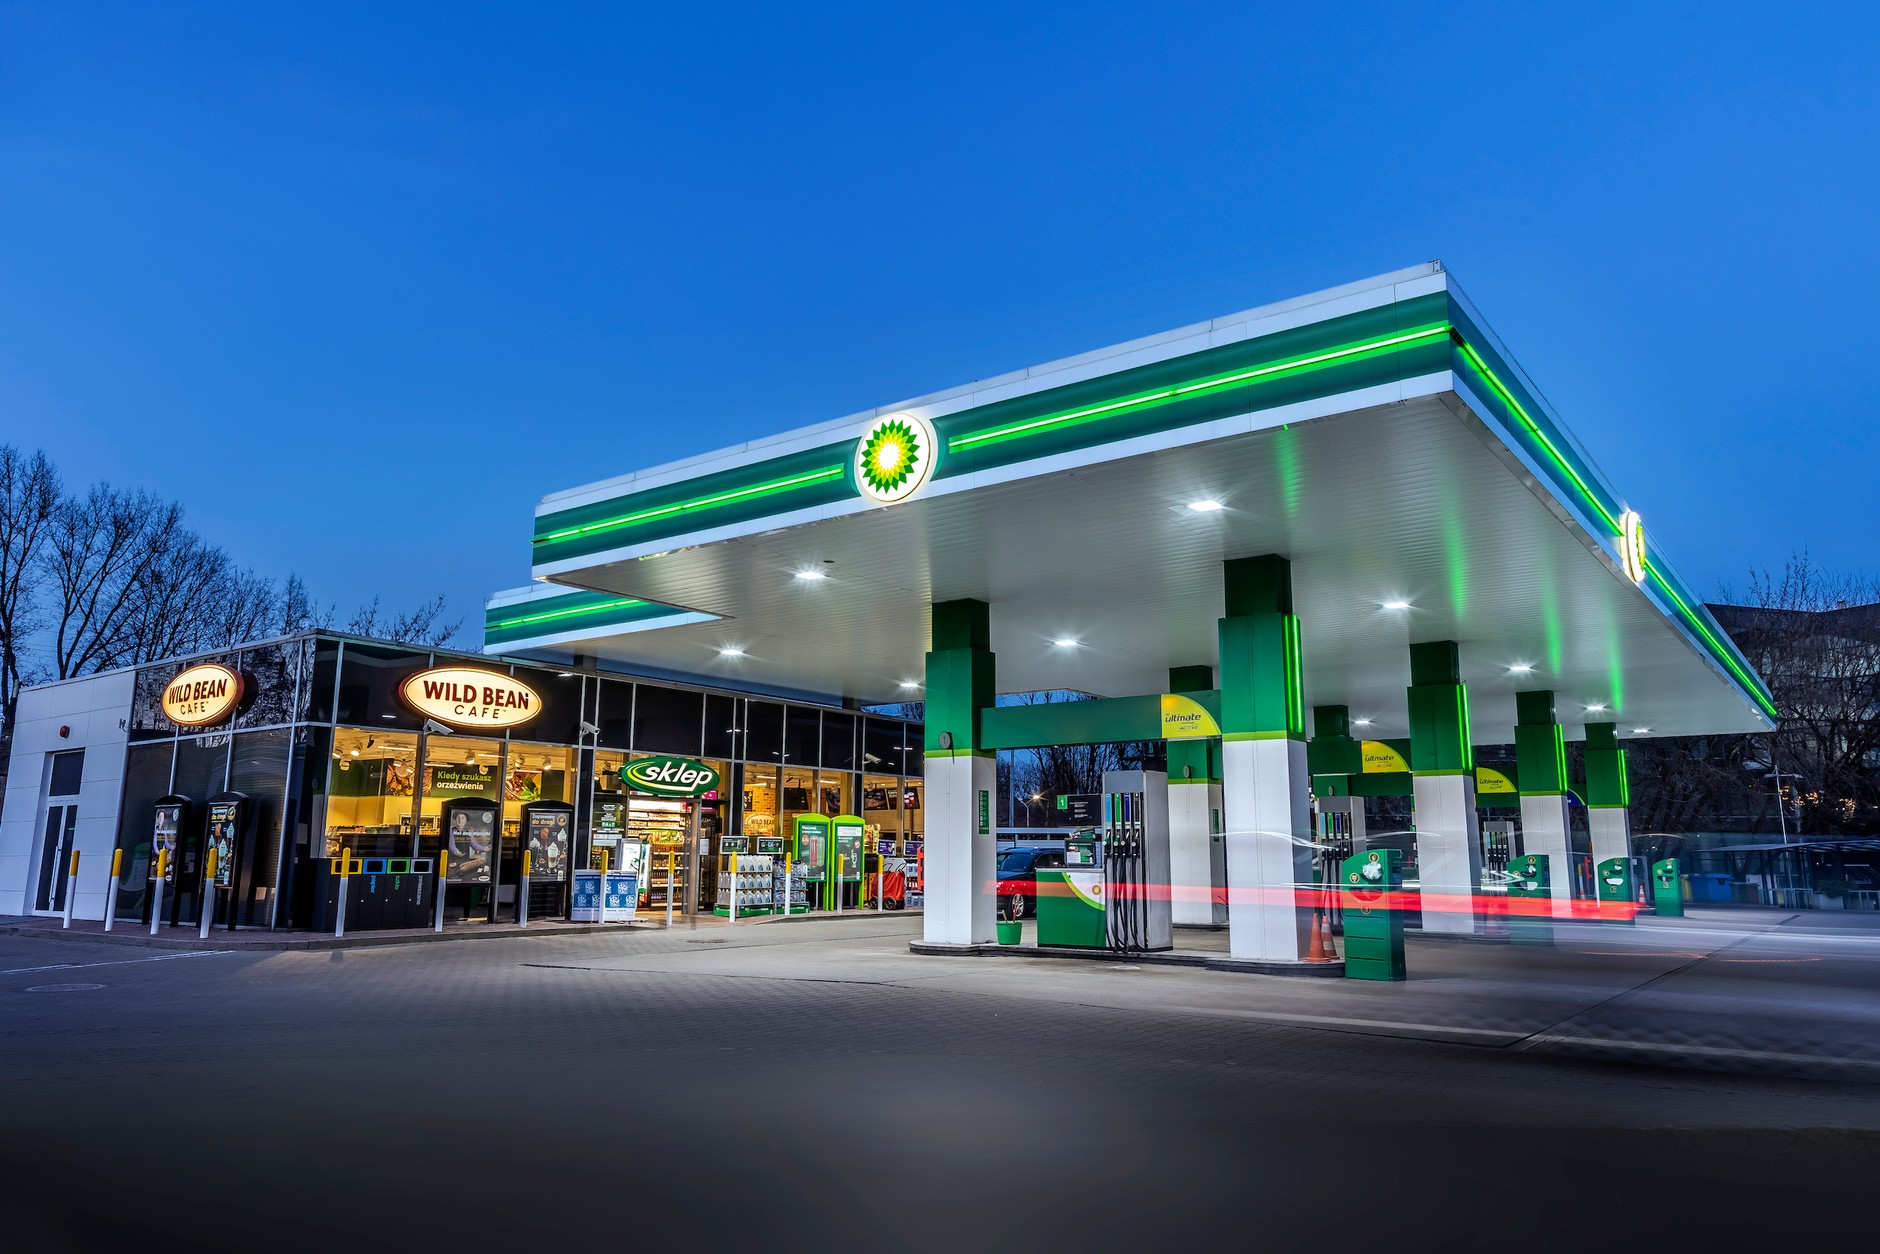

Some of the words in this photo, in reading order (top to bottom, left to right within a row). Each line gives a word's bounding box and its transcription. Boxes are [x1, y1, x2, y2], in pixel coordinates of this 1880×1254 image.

[168, 684, 192, 705] WILD
[193, 679, 228, 701] BEAN
[423, 680, 477, 704] WILD
[482, 687, 530, 710] BEAN
[180, 701, 206, 715] CAFE
[454, 704, 500, 719] CAFE
[1165, 713, 1201, 722] ultimate
[437, 771, 460, 782] Kiedy
[461, 773, 492, 782] szukasz
[644, 761, 713, 791] sklep
[436, 781, 484, 791] orzeźwienia
